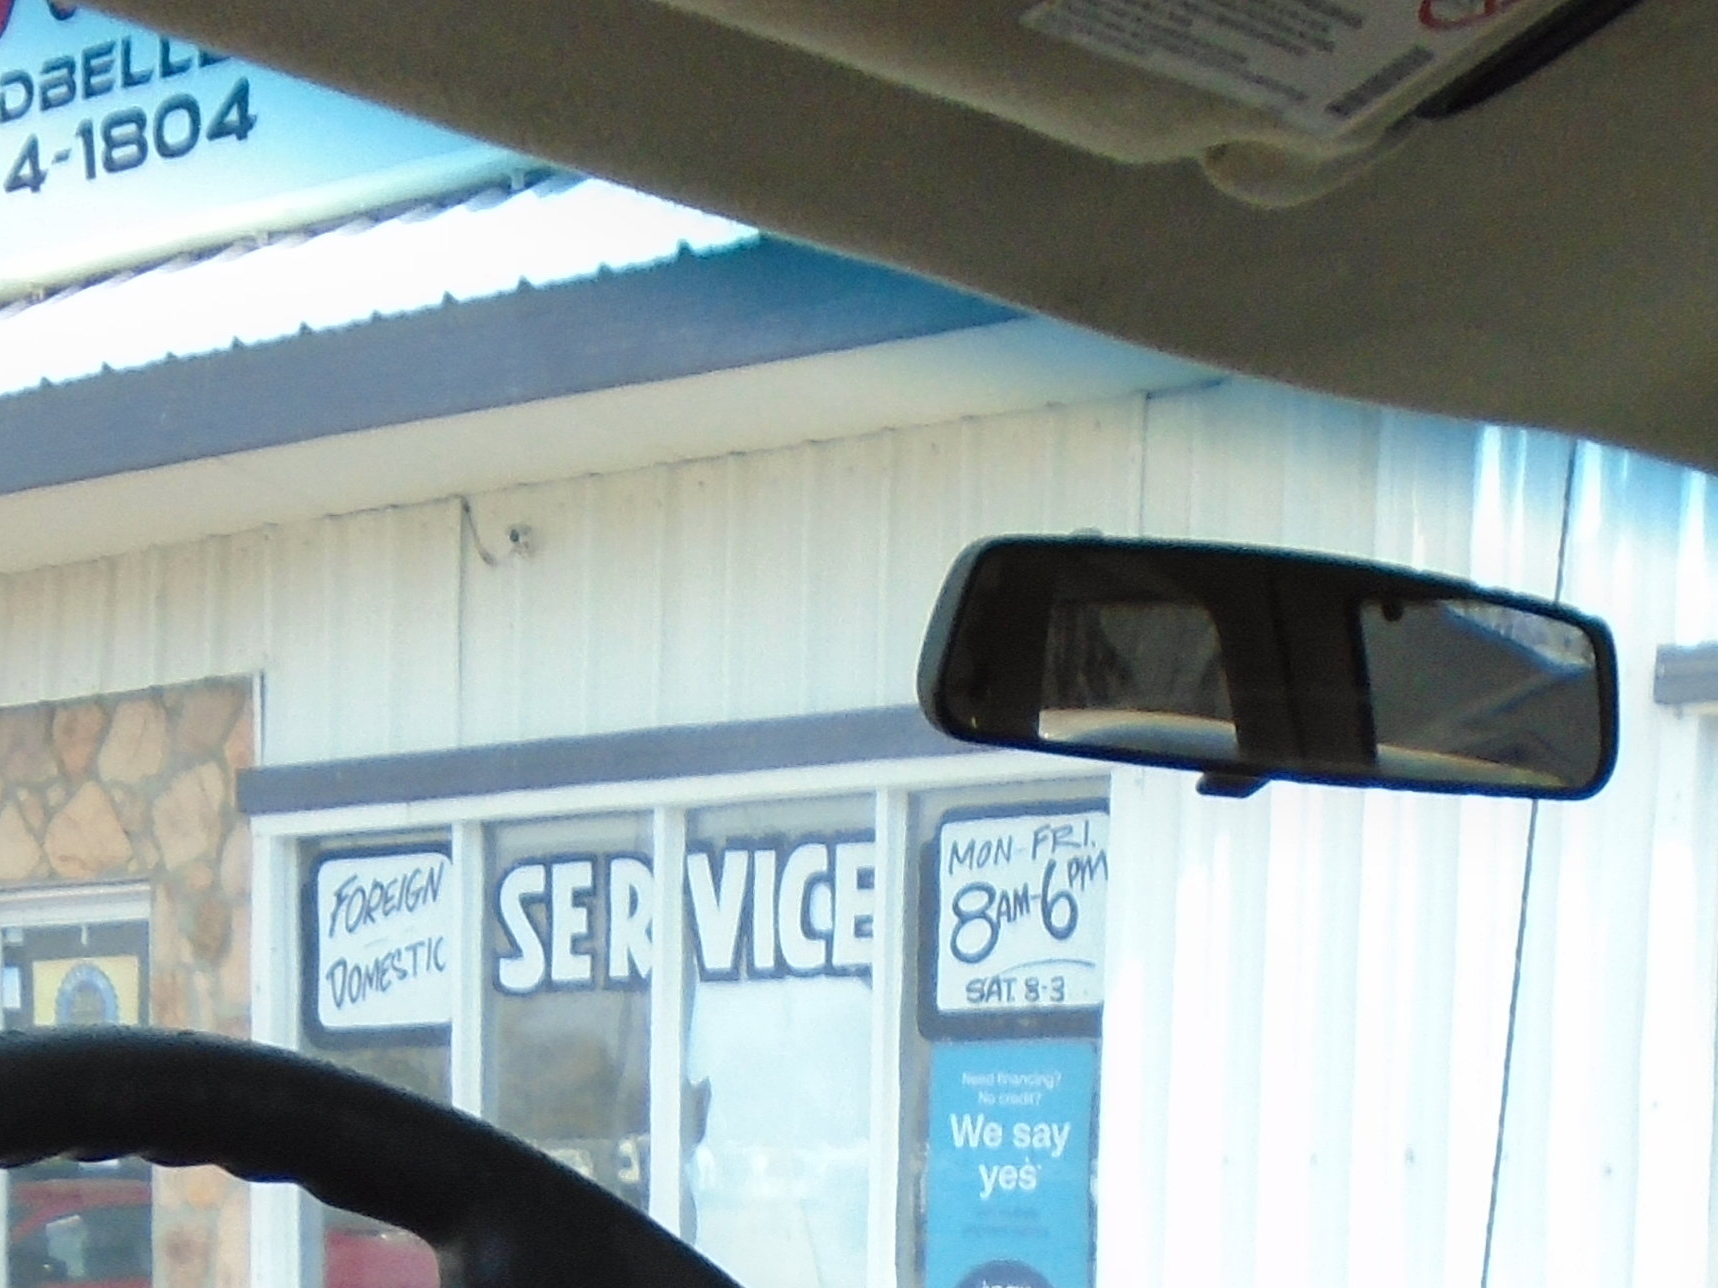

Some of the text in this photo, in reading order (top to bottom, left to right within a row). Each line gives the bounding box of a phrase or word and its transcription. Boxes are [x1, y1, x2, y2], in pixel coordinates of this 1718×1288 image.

[328, 861, 445, 939] FOREIGN
[493, 830, 877, 998] SERVICE
[325, 936, 447, 1010] DOMESTIC
[997, 1071, 1062, 1090] financing?
[999, 1091, 1042, 1106] credit?
[949, 1113, 1071, 1158] We say
